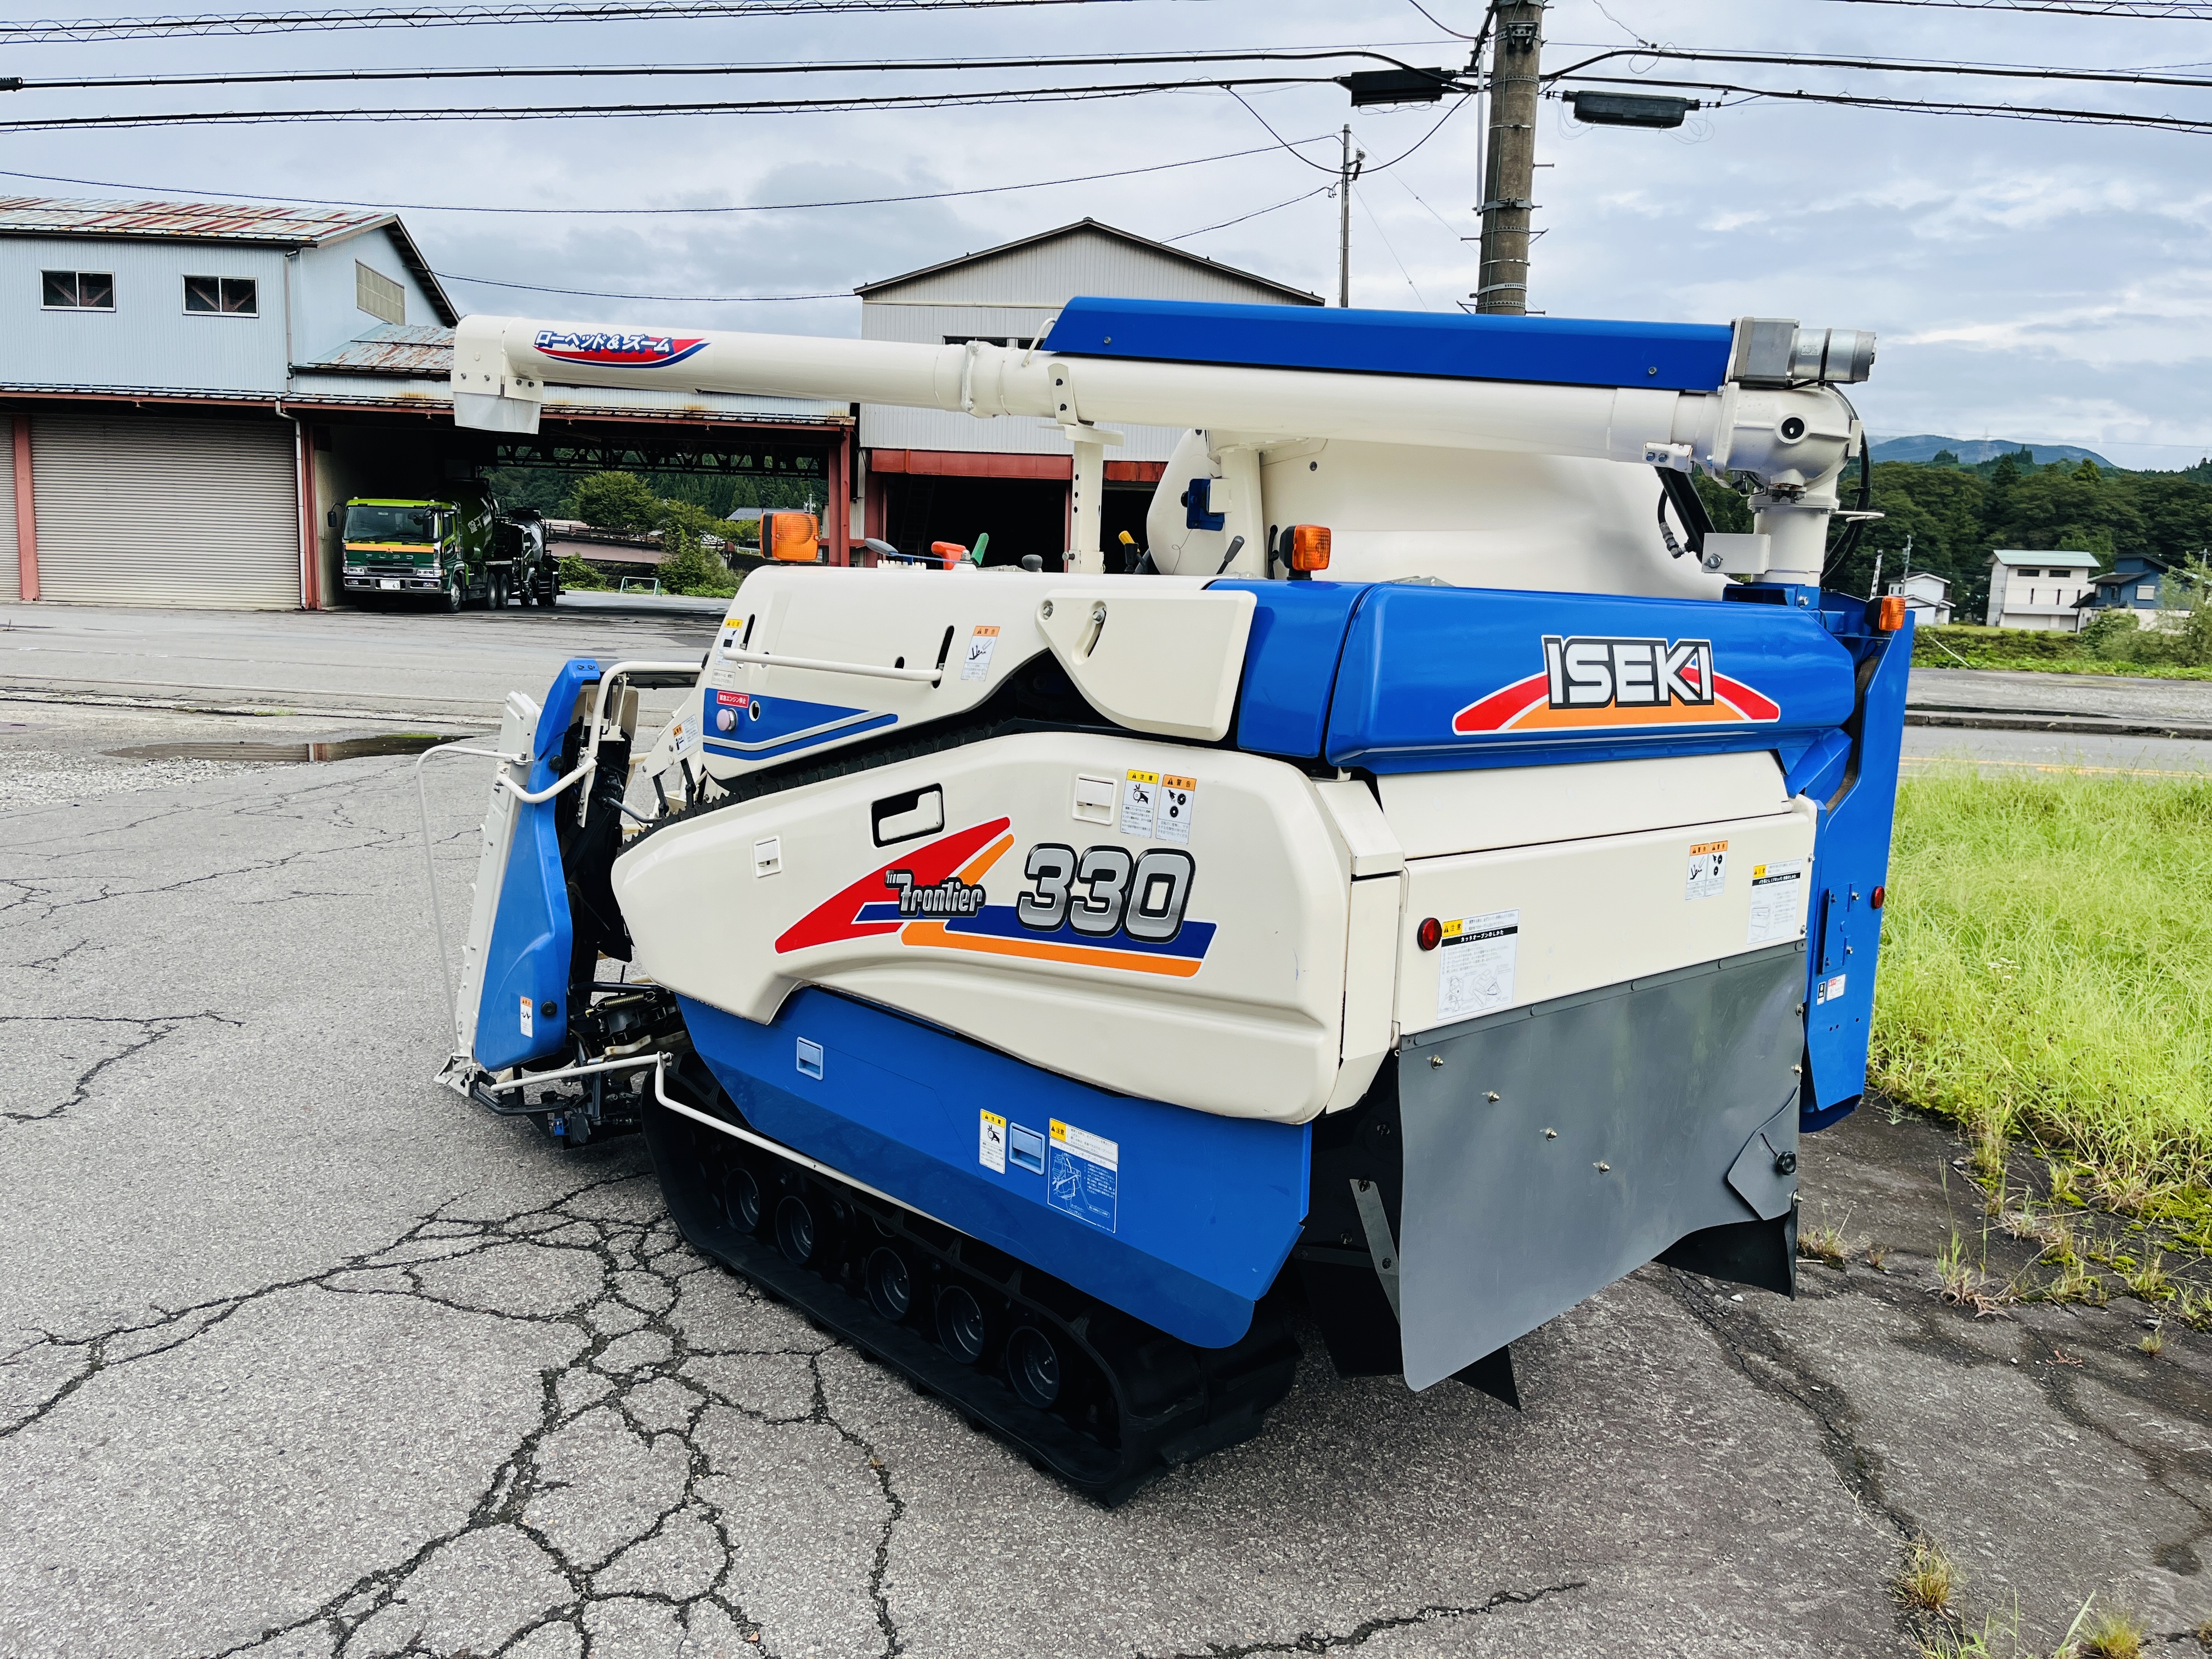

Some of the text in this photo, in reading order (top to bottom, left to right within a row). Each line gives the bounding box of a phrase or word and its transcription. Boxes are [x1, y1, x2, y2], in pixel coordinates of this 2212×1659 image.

[535, 331, 672, 355] ローヘッド&ズーム
[1544, 639, 1713, 709] ISEKI
[885, 844, 1195, 942] Frontier 330
[1450, 923, 1461, 932] 注意
[1460, 929, 1504, 943] カッタオープンのしかた
